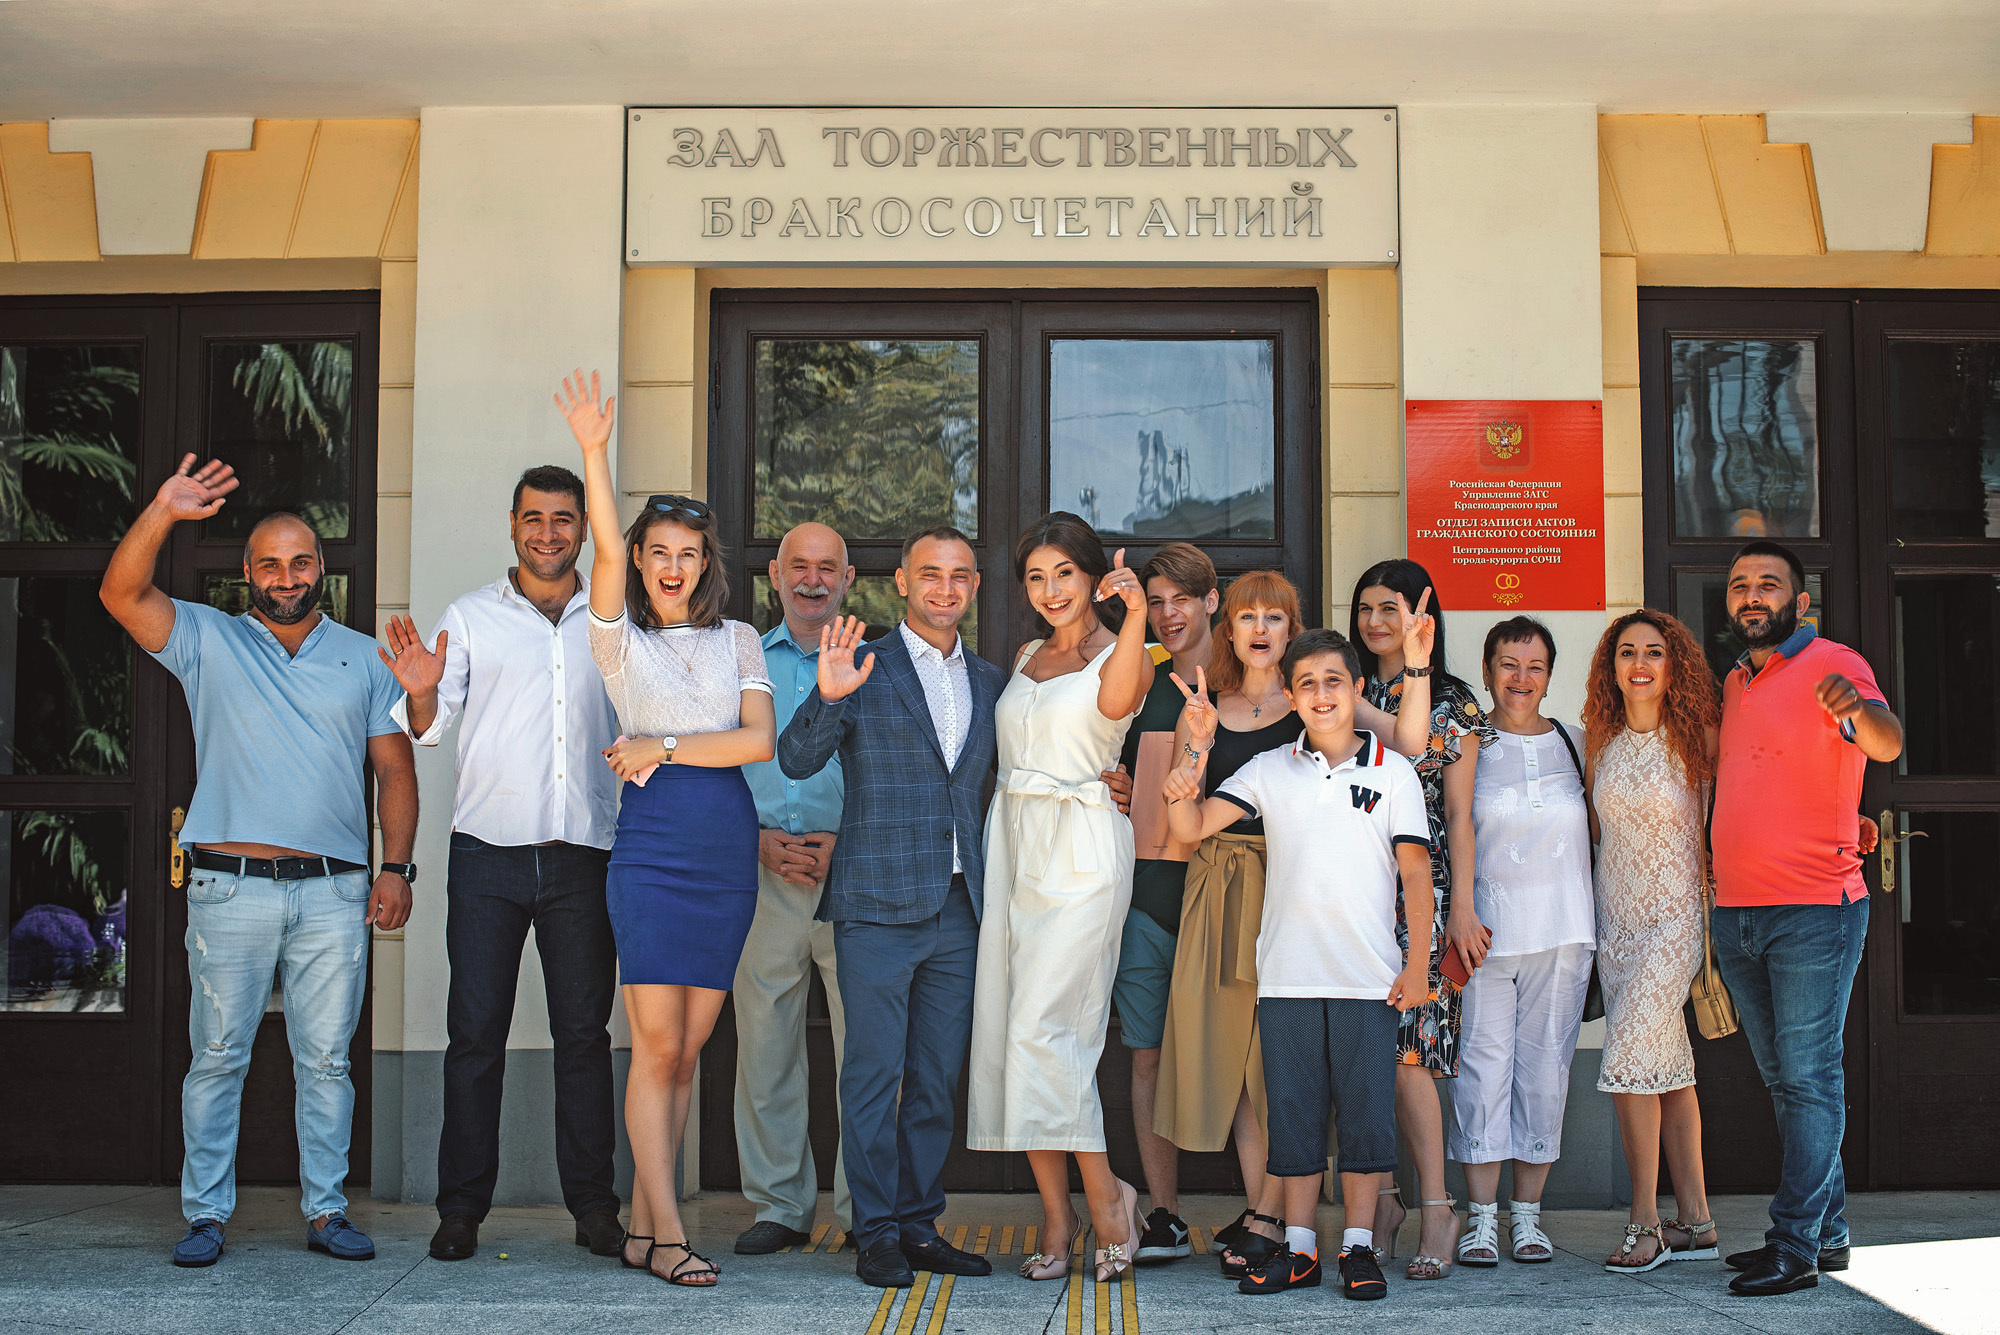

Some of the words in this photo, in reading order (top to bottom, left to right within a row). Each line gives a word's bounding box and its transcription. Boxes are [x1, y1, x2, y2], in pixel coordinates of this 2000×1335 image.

[667, 127, 785, 168] ЗАЛ
[822, 127, 1358, 168] ТОРЖЕСТВЕННЫХ
[701, 182, 1323, 238] БРАКОСОЧЕТАНИЙ
[1449, 480, 1506, 490] Российская
[1508, 480, 1562, 490] Федерация
[1462, 491, 1522, 500] Управление
[1523, 491, 1550, 499] ЗАГС
[1454, 501, 1533, 511] Краснодарского
[1535, 502, 1558, 511] края
[1436, 518, 1478, 528] ОТДЕЛ
[1480, 518, 1533, 527] ЗАПИСИ
[1535, 518, 1576, 527] АКТОВ
[1416, 529, 1519, 539] ГРАЖДАНСКОГО
[1520, 529, 1597, 538] СОСТОЯНИЯ
[1452, 546, 1524, 555] Центрального
[1525, 546, 1562, 555] района
[1452, 555, 1529, 565] города-курорта
[1531, 555, 1562, 564] СОЧИ
